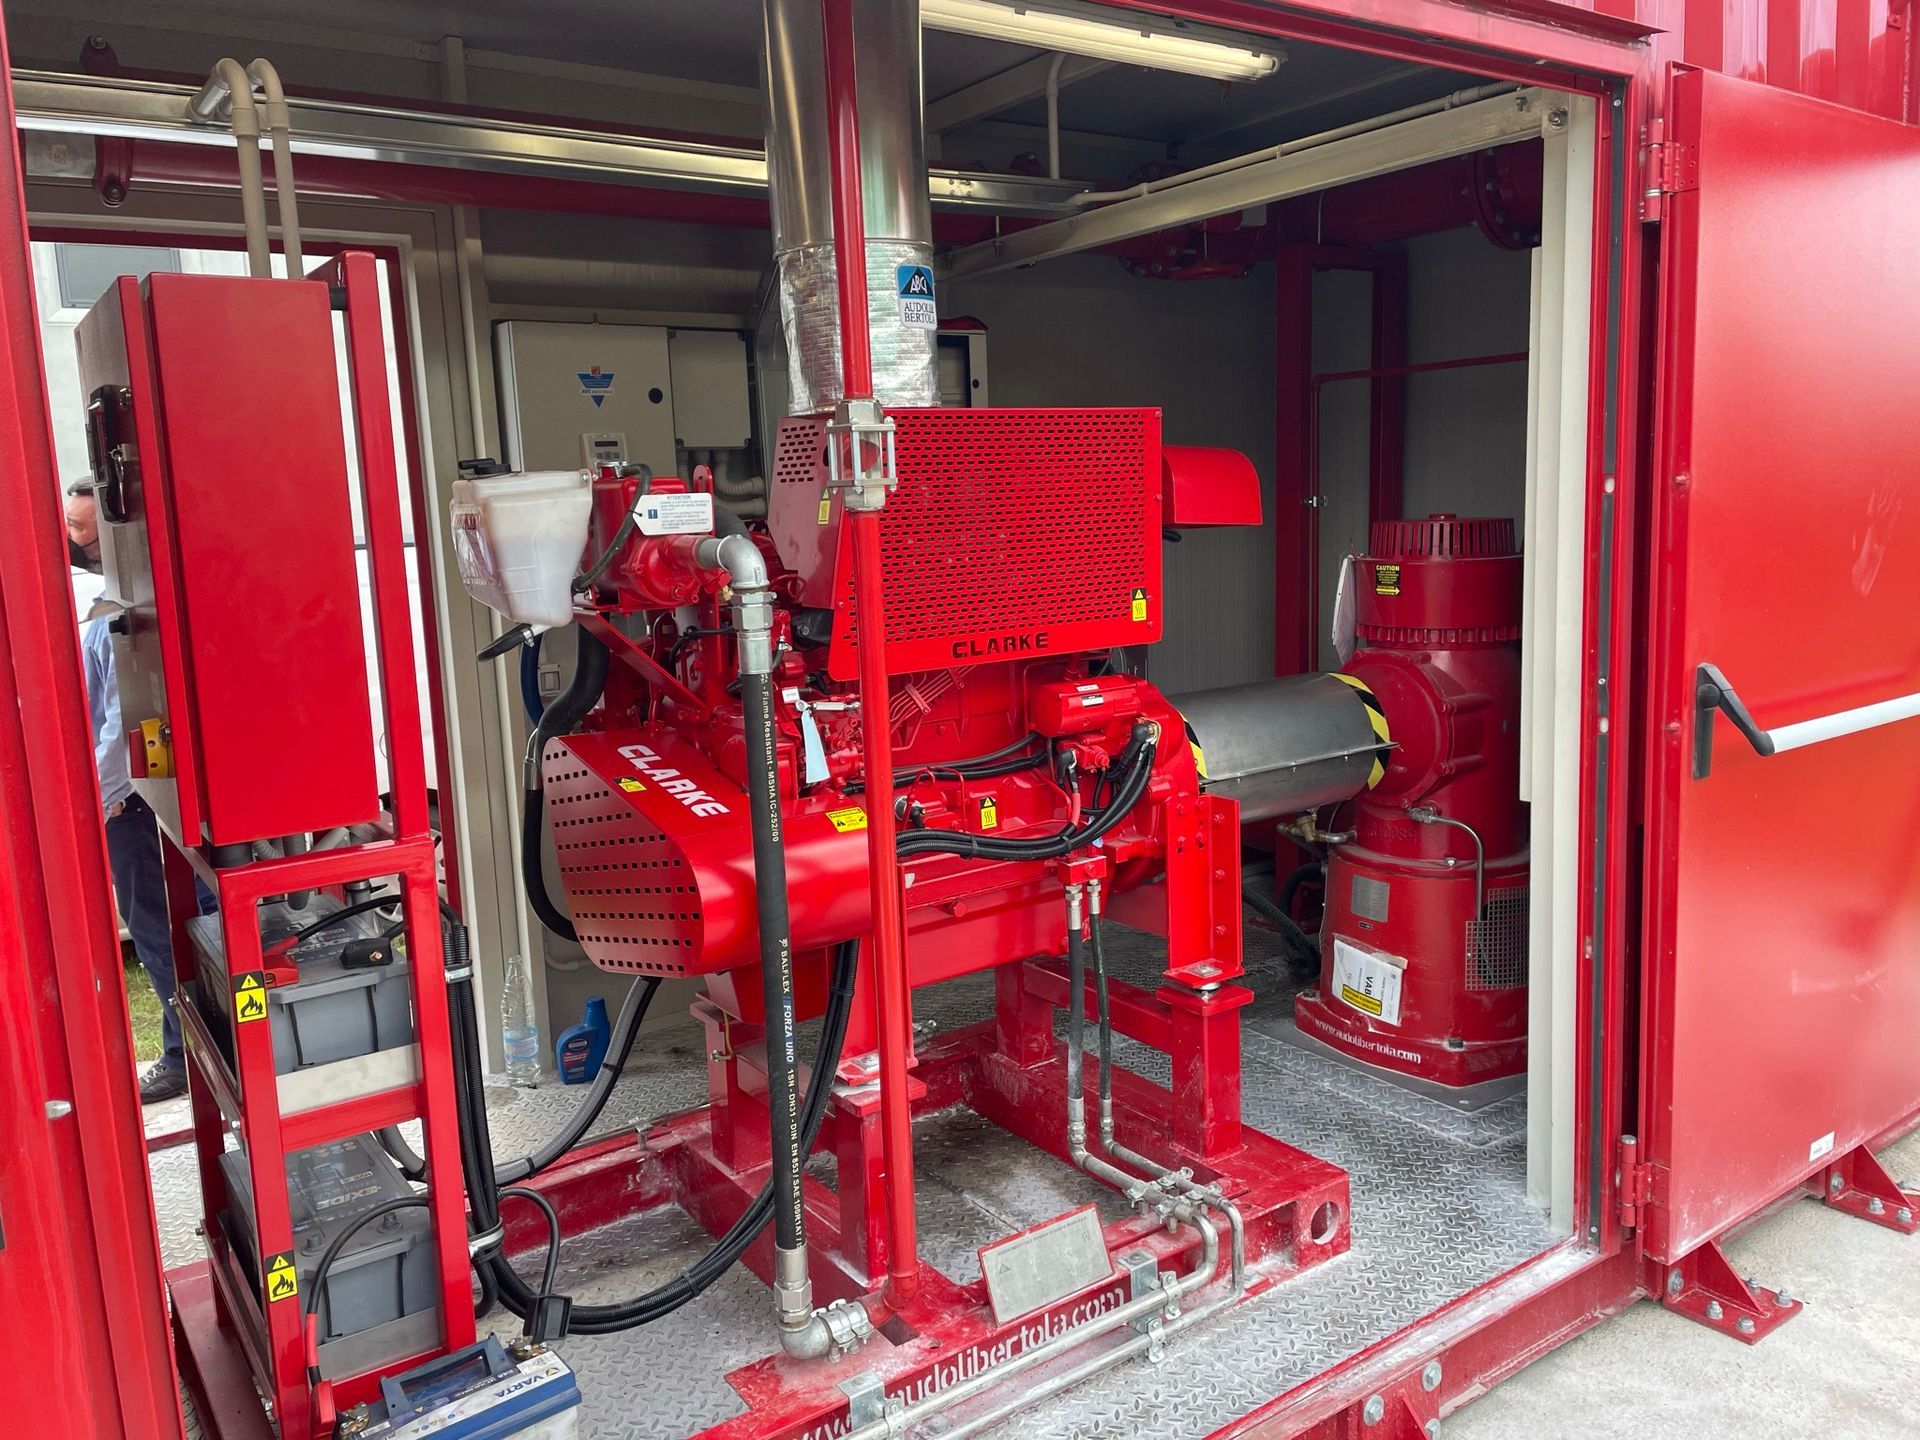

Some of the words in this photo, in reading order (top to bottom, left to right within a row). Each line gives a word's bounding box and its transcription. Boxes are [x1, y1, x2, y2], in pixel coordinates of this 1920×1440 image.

[951, 631, 1049, 659] CLARKE
[762, 691, 770, 719] Flame
[764, 720, 774, 765] Resistant
[617, 744, 731, 818] CLARKE
[768, 771, 776, 799] MSHA
[780, 950, 790, 994] BALFLEX
[1364, 976, 1374, 996] VAB
[783, 1004, 793, 1038] FORZA
[785, 1041, 794, 1063] UNO
[788, 1093, 797, 1117] DN31
[790, 1123, 798, 1141] DIN
[791, 1142, 799, 1157] EN
[316, 1185, 382, 1211] EXIDE
[493, 1375, 545, 1398] VARTA
